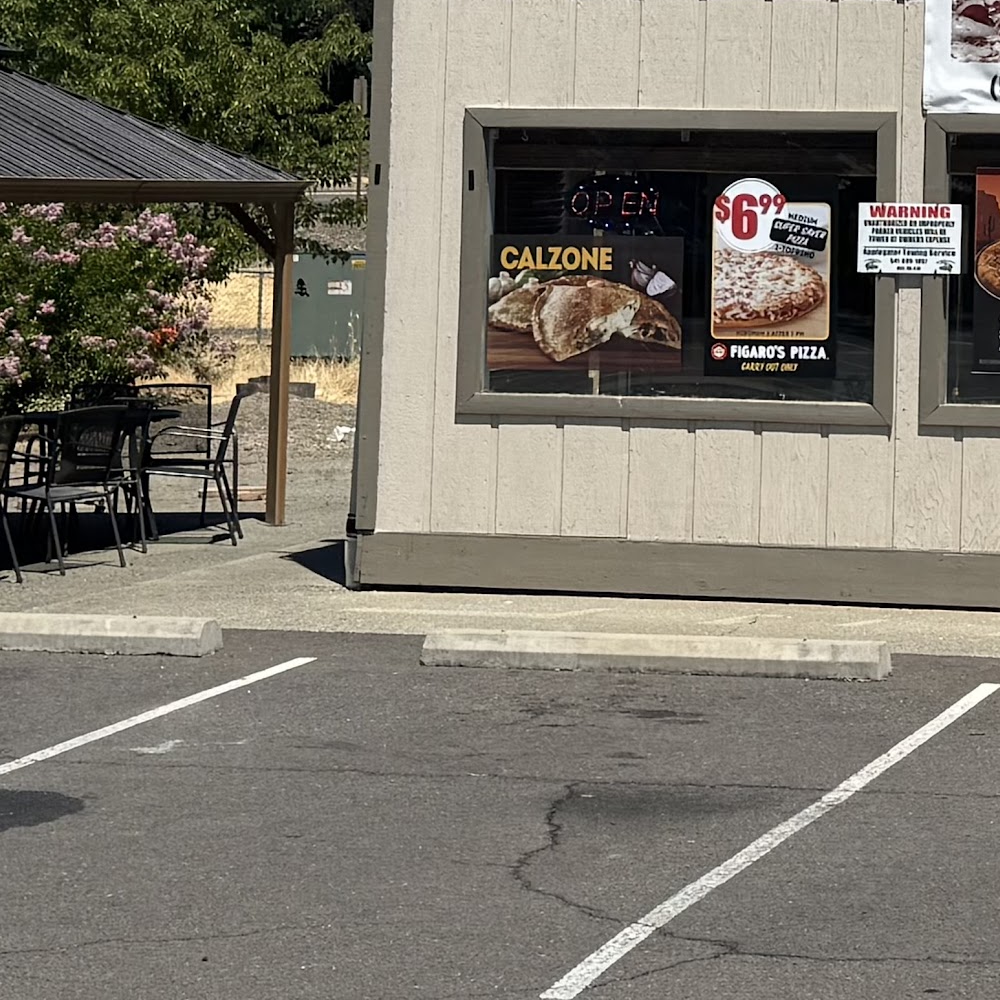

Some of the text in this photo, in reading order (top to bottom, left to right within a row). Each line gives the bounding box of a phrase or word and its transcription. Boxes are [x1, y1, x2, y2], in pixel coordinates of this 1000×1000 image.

[571, 190, 660, 216] OPEN
[869, 205, 952, 219] WARNING
[499, 245, 614, 271] CALZONE
[729, 344, 827, 360] FIGARO'S PIZZA
